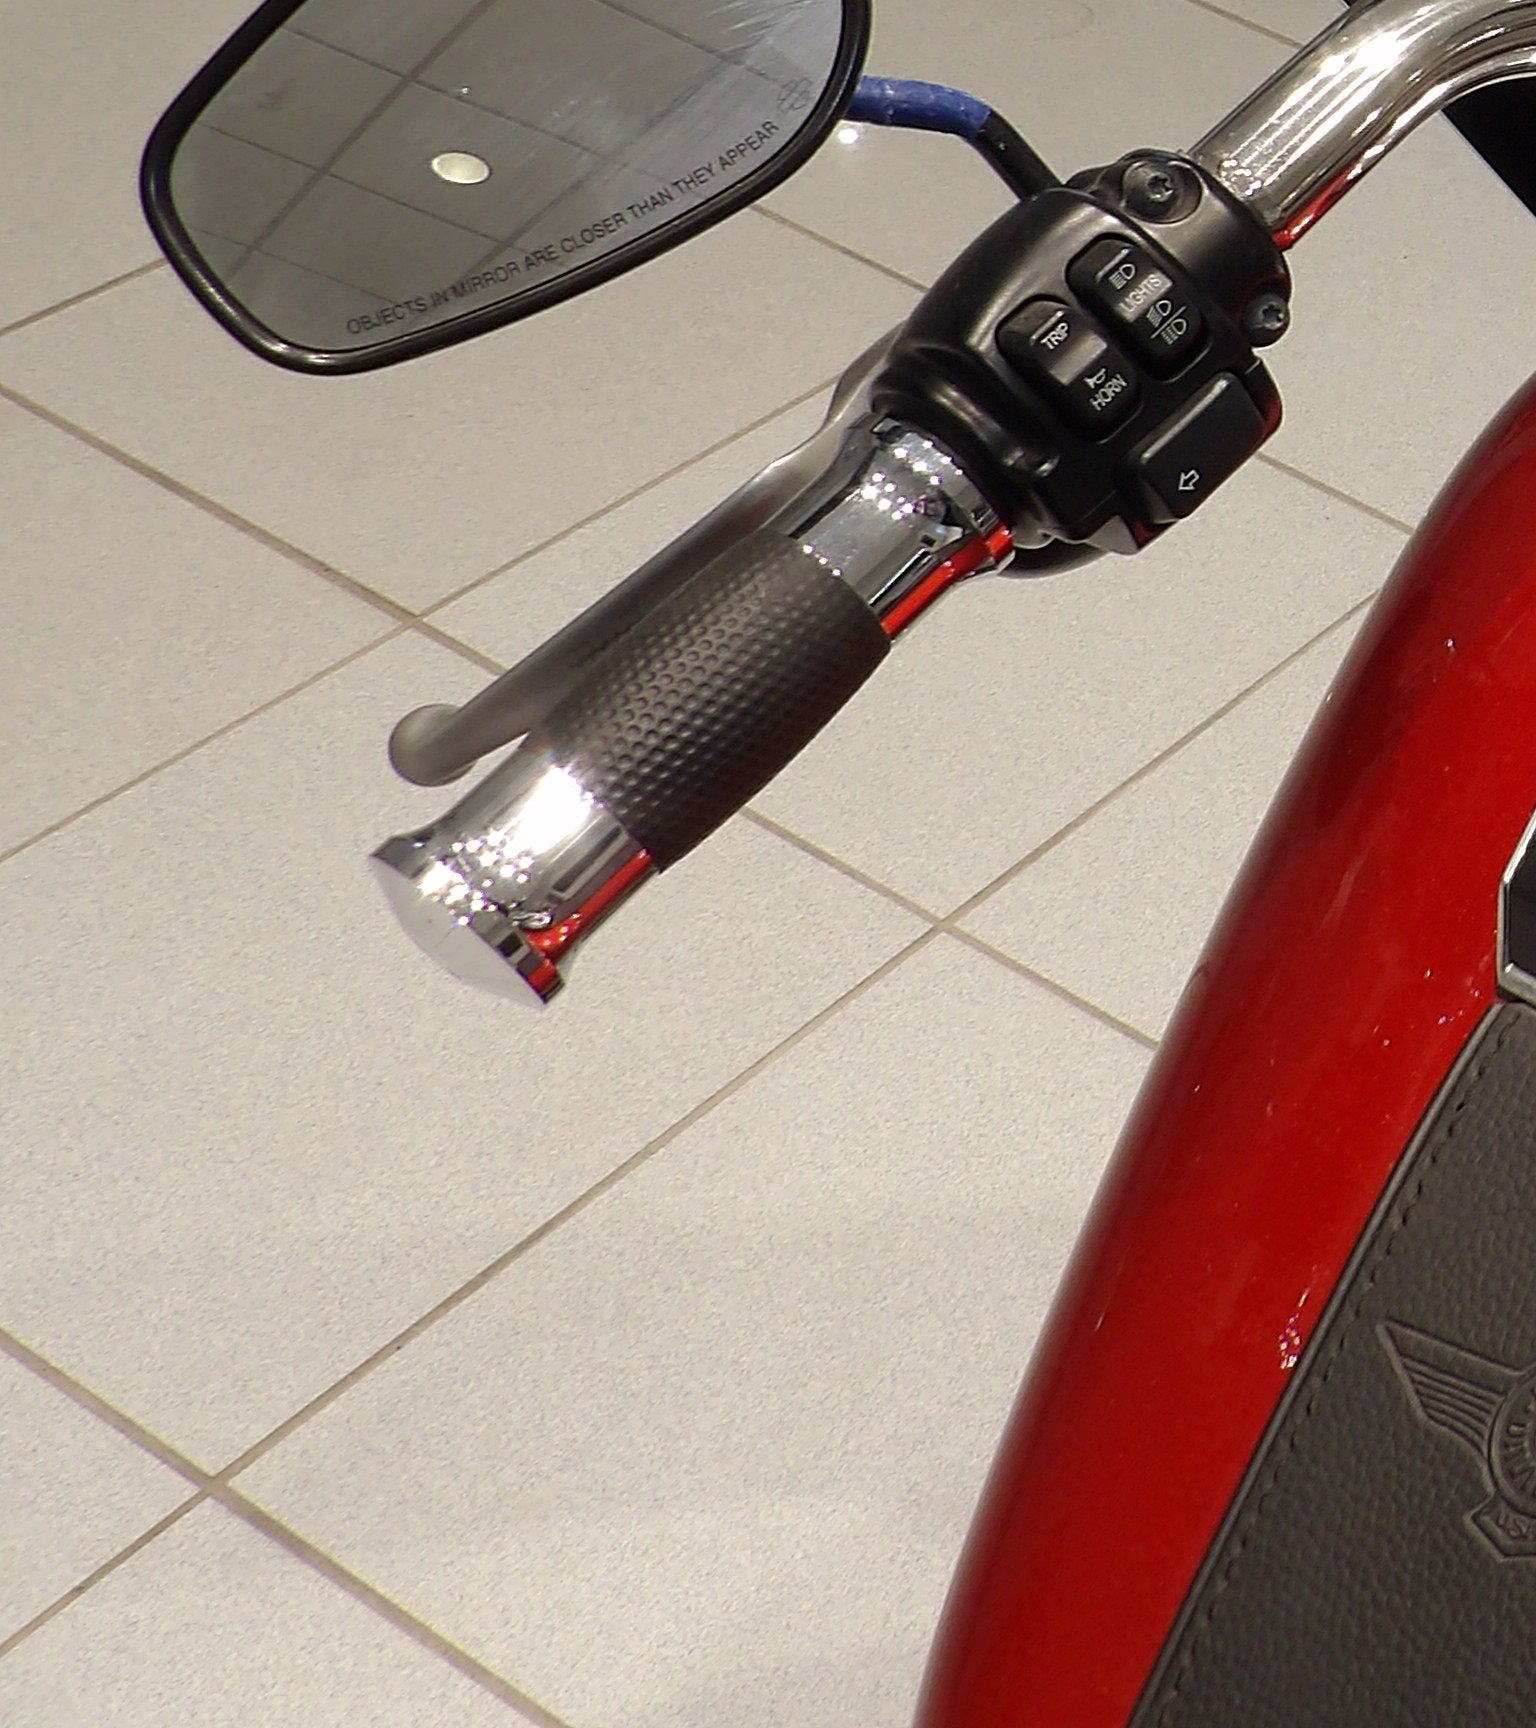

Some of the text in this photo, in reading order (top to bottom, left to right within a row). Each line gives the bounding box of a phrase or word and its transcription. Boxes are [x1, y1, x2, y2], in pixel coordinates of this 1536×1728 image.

[346, 120, 779, 335] OBJECTS IN MIRROR ARE CLOSER THAN THEY APPEAR
[1118, 273, 1161, 312] LIGHTS
[1040, 322, 1069, 350] TRIP
[1089, 373, 1128, 411] HORN
